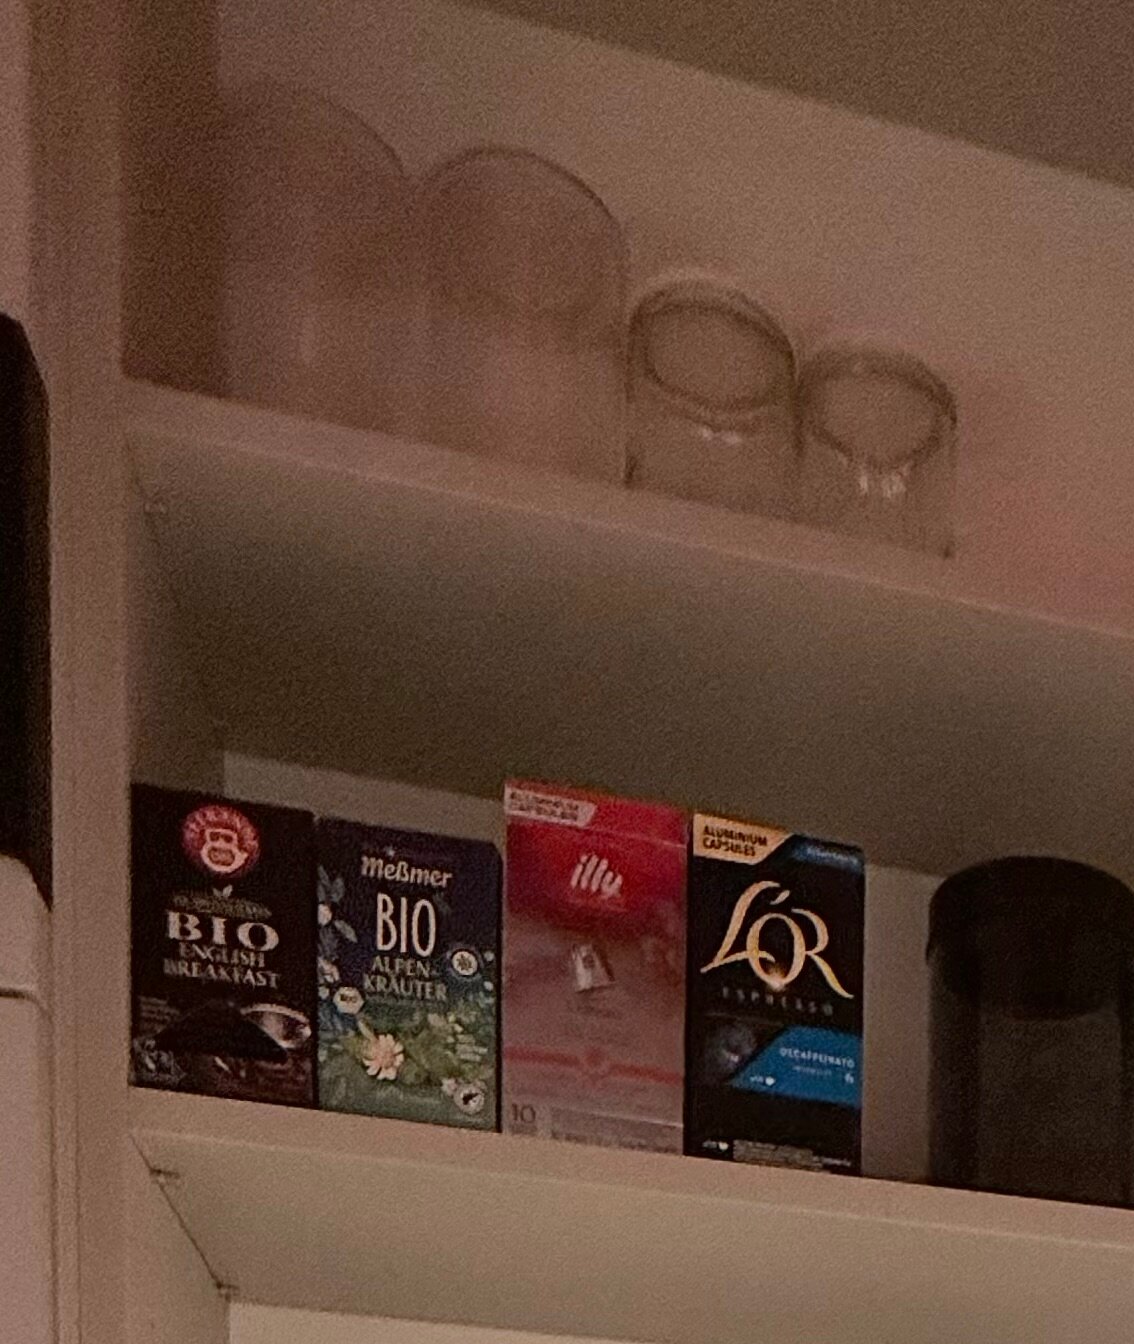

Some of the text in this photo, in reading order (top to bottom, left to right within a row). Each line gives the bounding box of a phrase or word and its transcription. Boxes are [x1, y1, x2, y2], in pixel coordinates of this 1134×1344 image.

[703, 825, 767, 846] ALUMINIUM
[703, 836, 756, 857] CAPSULES
[361, 856, 453, 888] Meßmer
[570, 854, 624, 899] illy
[166, 911, 280, 952] BIO
[377, 893, 437, 958] BIO
[179, 942, 266, 968] ENGLISH
[163, 958, 279, 989] BREAKFAST
[362, 973, 448, 1000] KRÄUTER
[511, 1103, 537, 1124] 10
